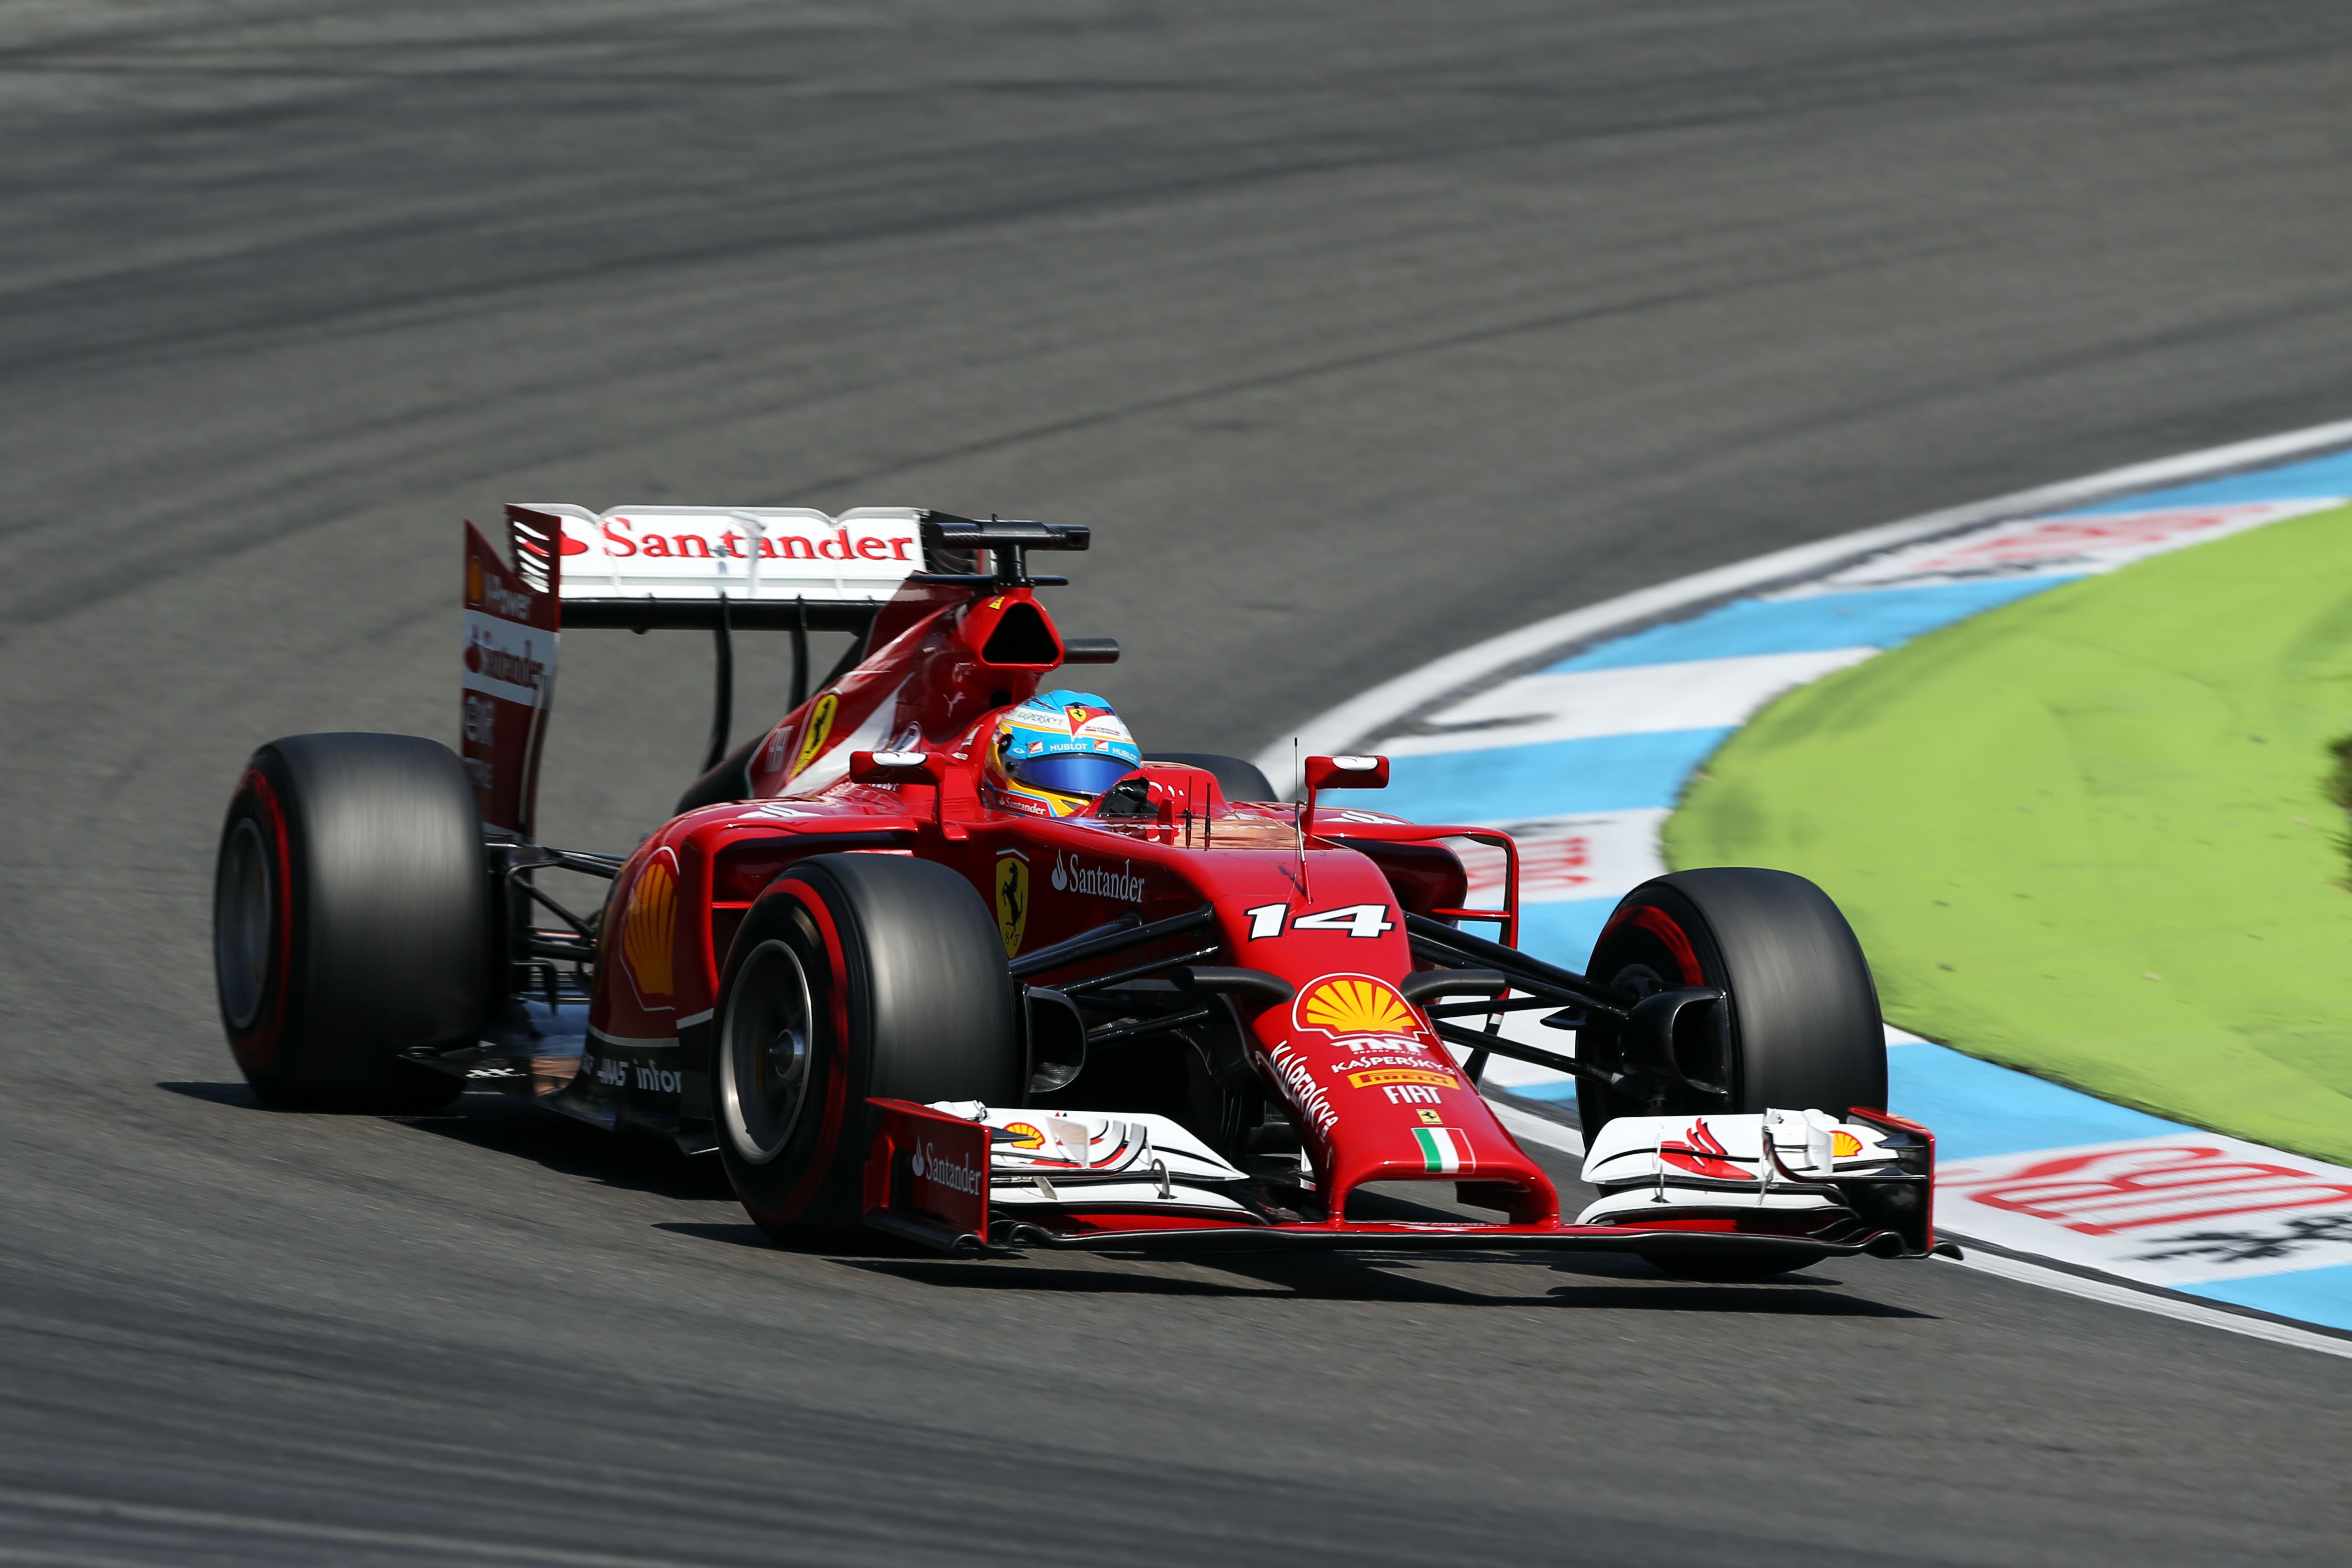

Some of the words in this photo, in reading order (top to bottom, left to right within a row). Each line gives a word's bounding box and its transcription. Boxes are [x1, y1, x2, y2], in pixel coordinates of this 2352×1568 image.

[602, 517, 912, 561] Santander
[1050, 743, 1088, 751] HUBLOT
[1112, 747, 1137, 762] HUBLOT
[1006, 797, 1046, 815] Santander
[1070, 853, 1145, 903] Santander
[1243, 903, 1396, 944] 14
[1330, 1038, 1429, 1052] TNT
[1330, 1056, 1443, 1073] KASPERSKY
[633, 1058, 682, 1094] infor
[1382, 1085, 1442, 1104] FIAT
[926, 1142, 982, 1196] Santander
